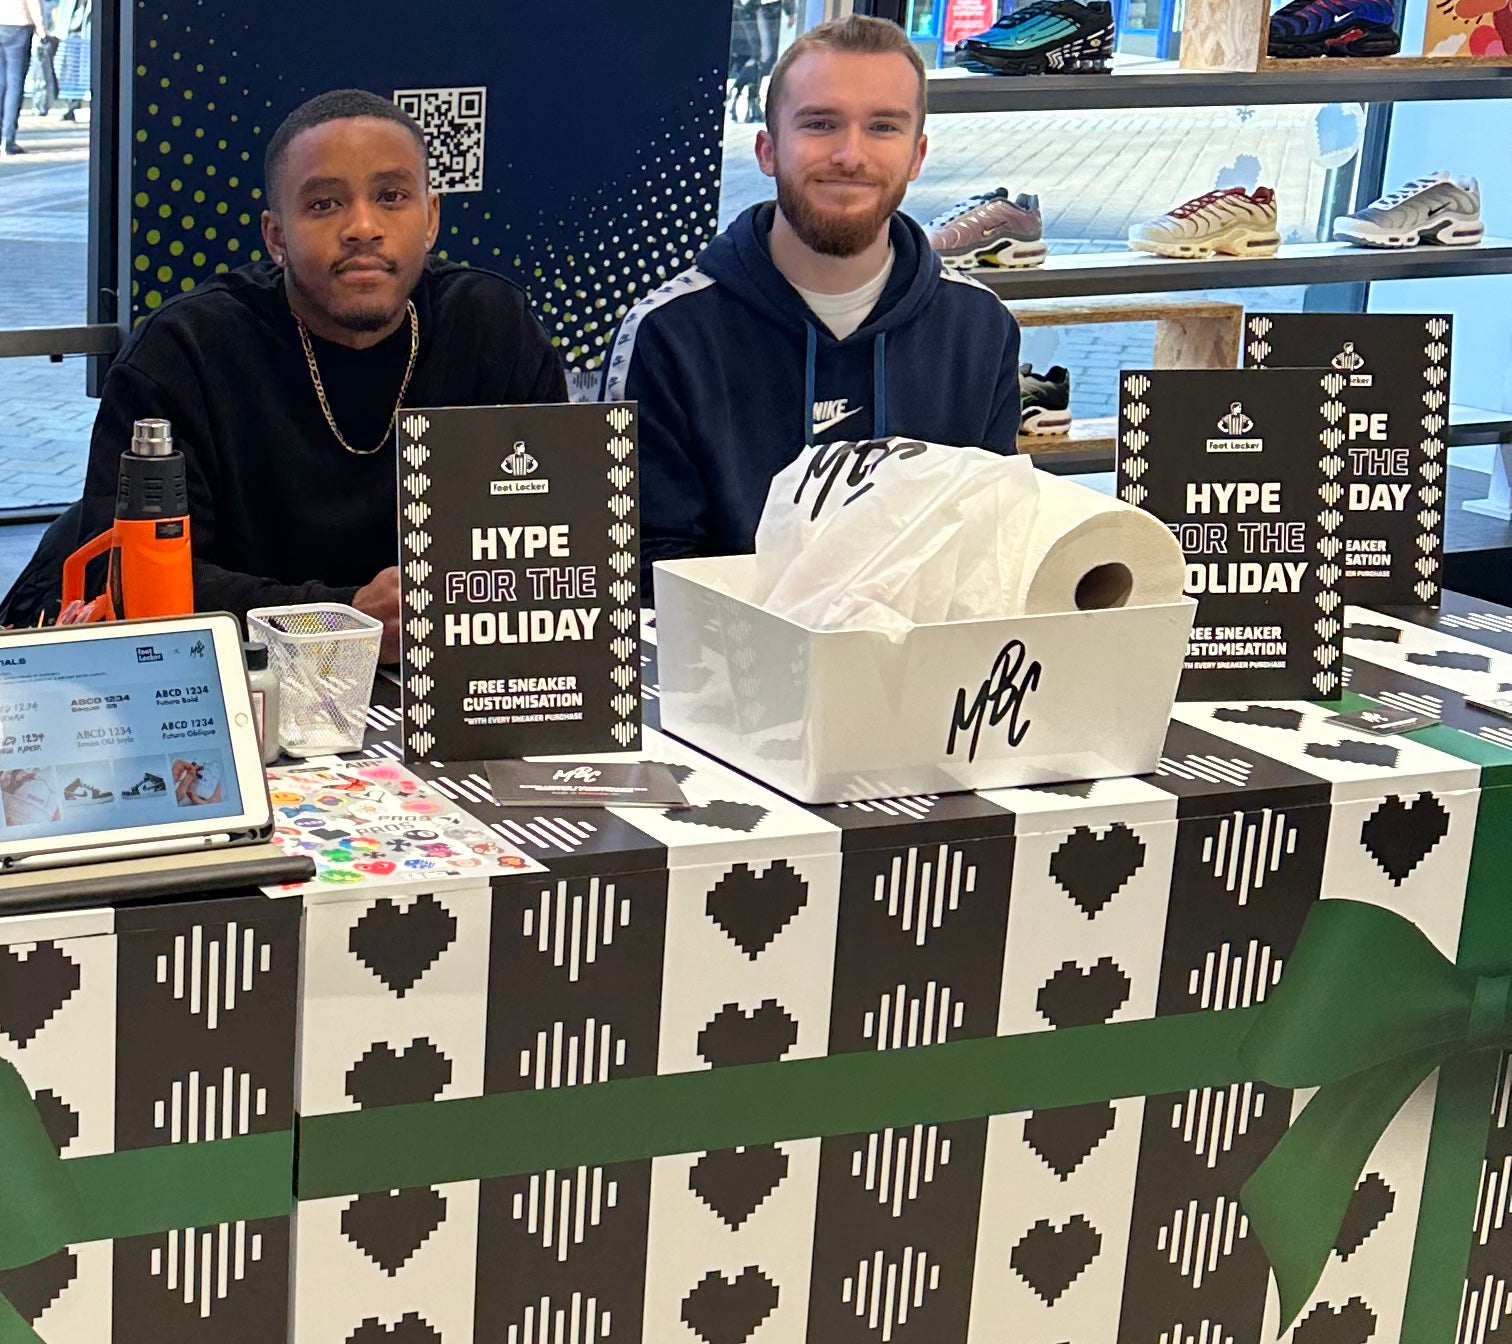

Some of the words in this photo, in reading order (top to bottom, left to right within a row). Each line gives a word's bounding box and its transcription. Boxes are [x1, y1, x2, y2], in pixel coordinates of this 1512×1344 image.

[812, 398, 849, 422] NIKE
[1348, 413, 1388, 441] PE
[1348, 447, 1410, 477] THE
[1185, 481, 1282, 515] HYPE
[471, 524, 571, 561] HYPE
[1238, 522, 1306, 553] THE
[445, 568, 517, 604] FOR
[526, 565, 597, 601] THE
[1183, 562, 1309, 594] OLIDAY
[444, 607, 601, 646] HOLIDAY
[1189, 626, 1213, 641] REE
[1215, 626, 1282, 640] SNEAKER
[155, 688, 182, 699] ABCD
[185, 685, 210, 696] 1234
[469, 679, 506, 695] FREE
[508, 676, 577, 693] SNEAKER
[71, 697, 102, 706] ABCD
[104, 694, 131, 703] 1234
[463, 692, 583, 712] CUSTOMISATION
[946, 638, 1042, 764] MBC
[76, 729, 106, 740] ABCD
[108, 726, 133, 737] 1234
[161, 720, 189, 731] ABCD
[191, 718, 215, 728] 1234
